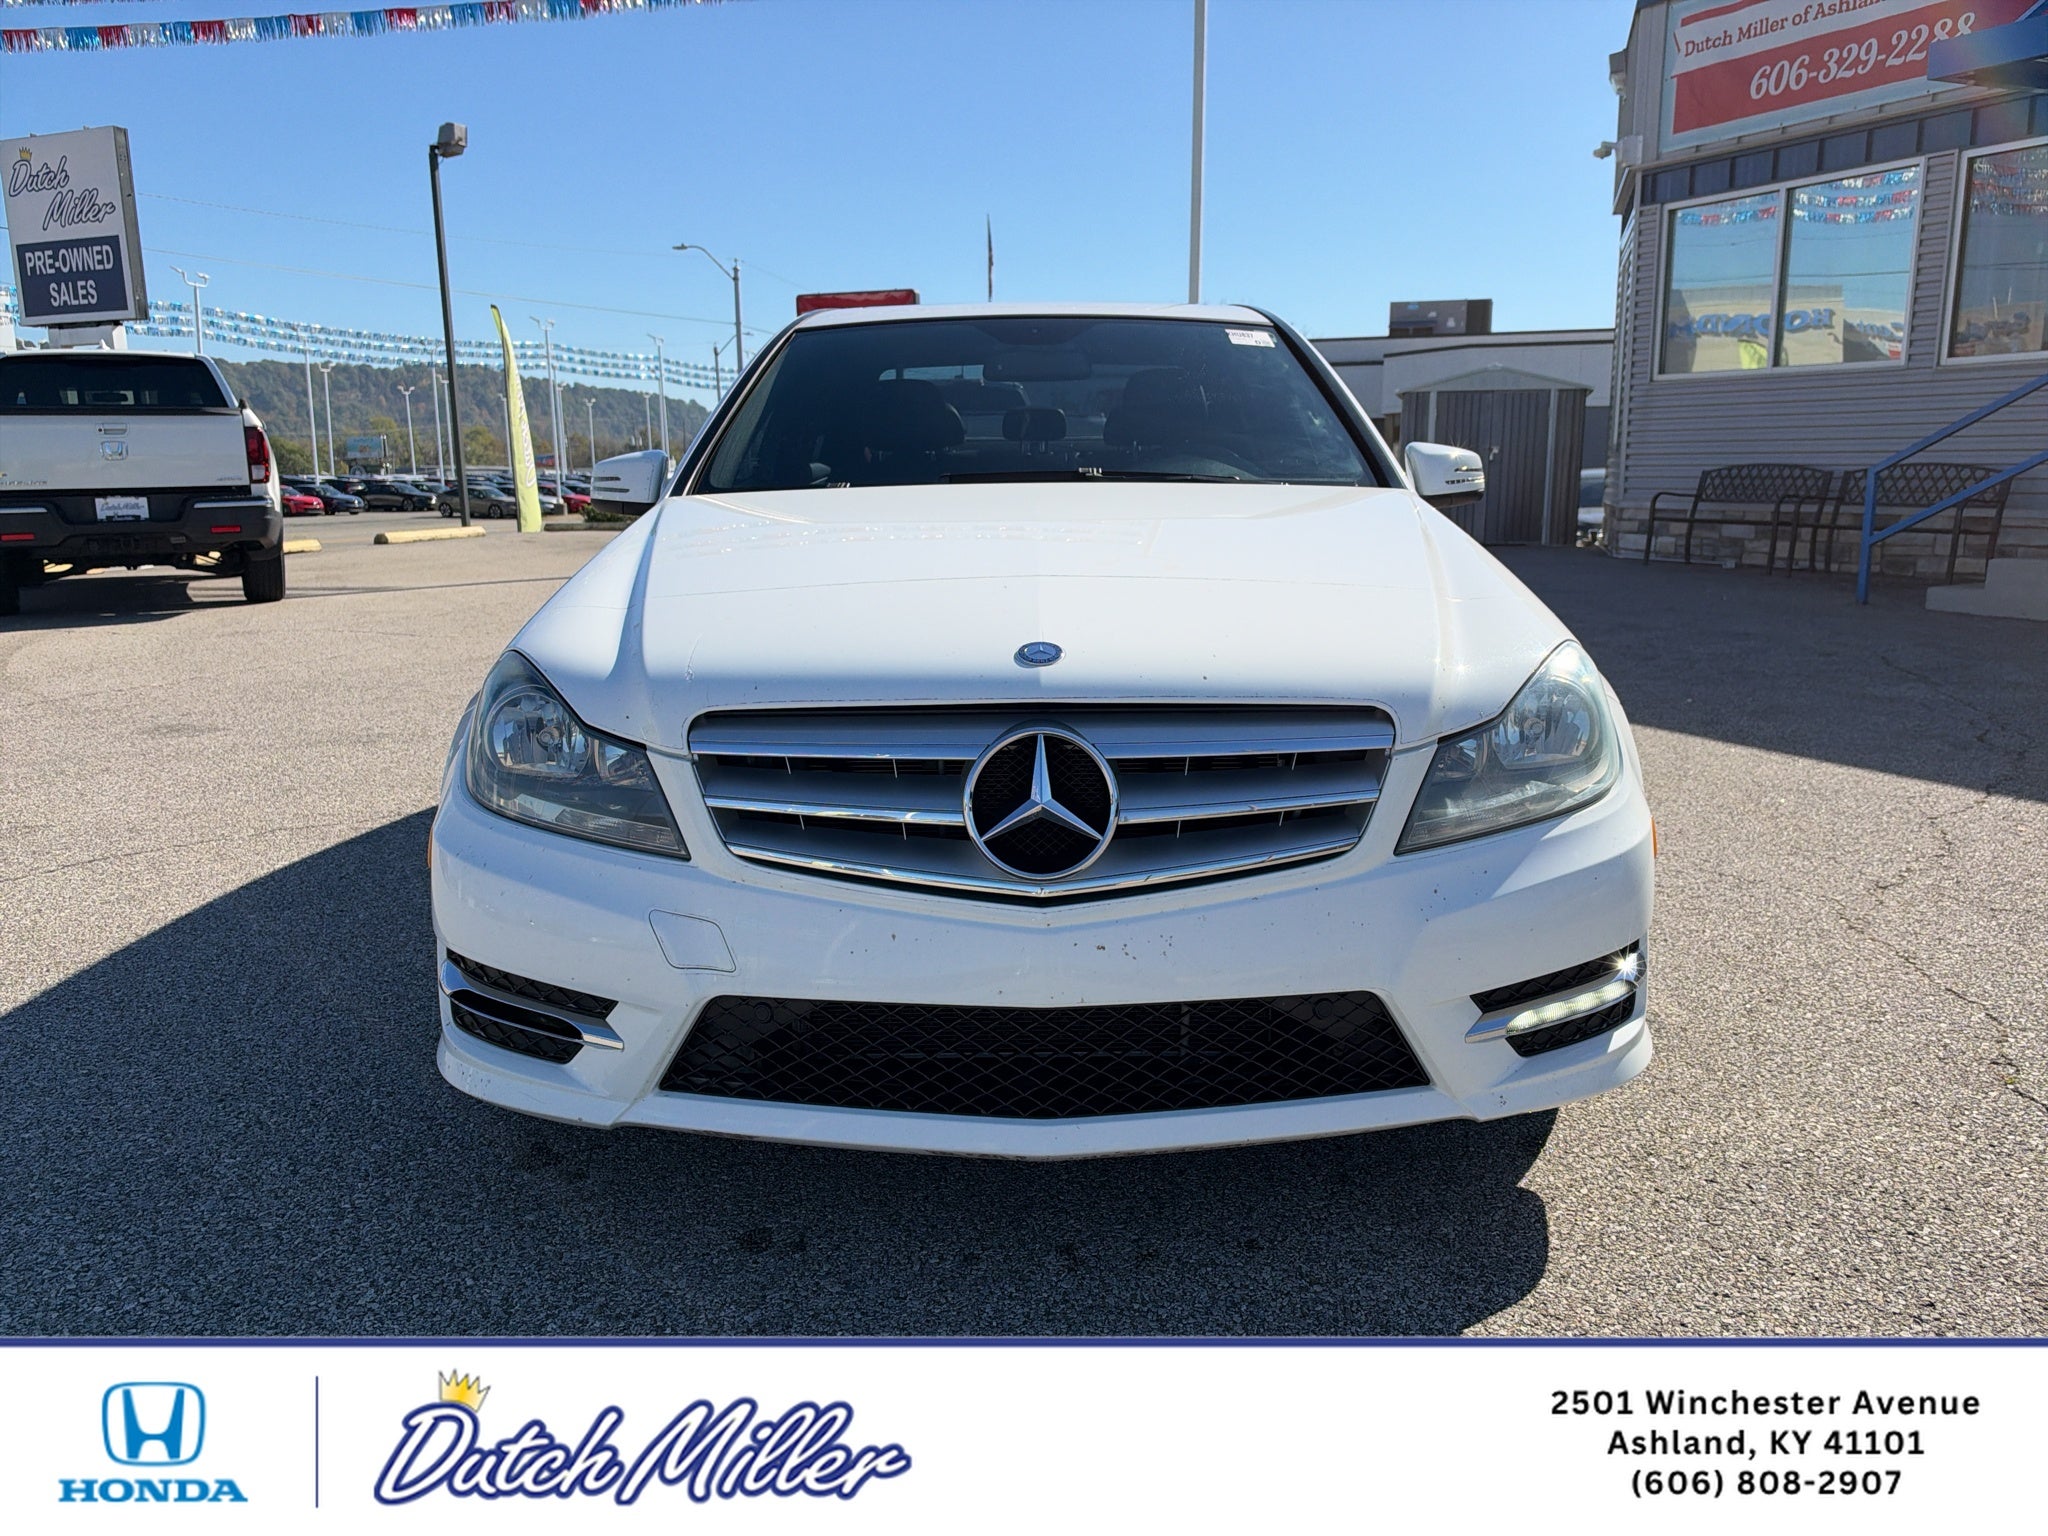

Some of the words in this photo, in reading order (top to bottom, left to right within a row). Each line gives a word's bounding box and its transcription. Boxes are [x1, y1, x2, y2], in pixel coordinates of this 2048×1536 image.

[1684, 30, 1733, 57] Dutch
[1736, 17, 1788, 43] Miller
[1792, 5, 1812, 26] of
[1750, 12, 1976, 100] 606-329-2288
[9, 155, 70, 197] Dutch
[42, 188, 116, 231] Miller
[25, 244, 114, 276] PRE-OWNED
[49, 279, 98, 307] SALES
